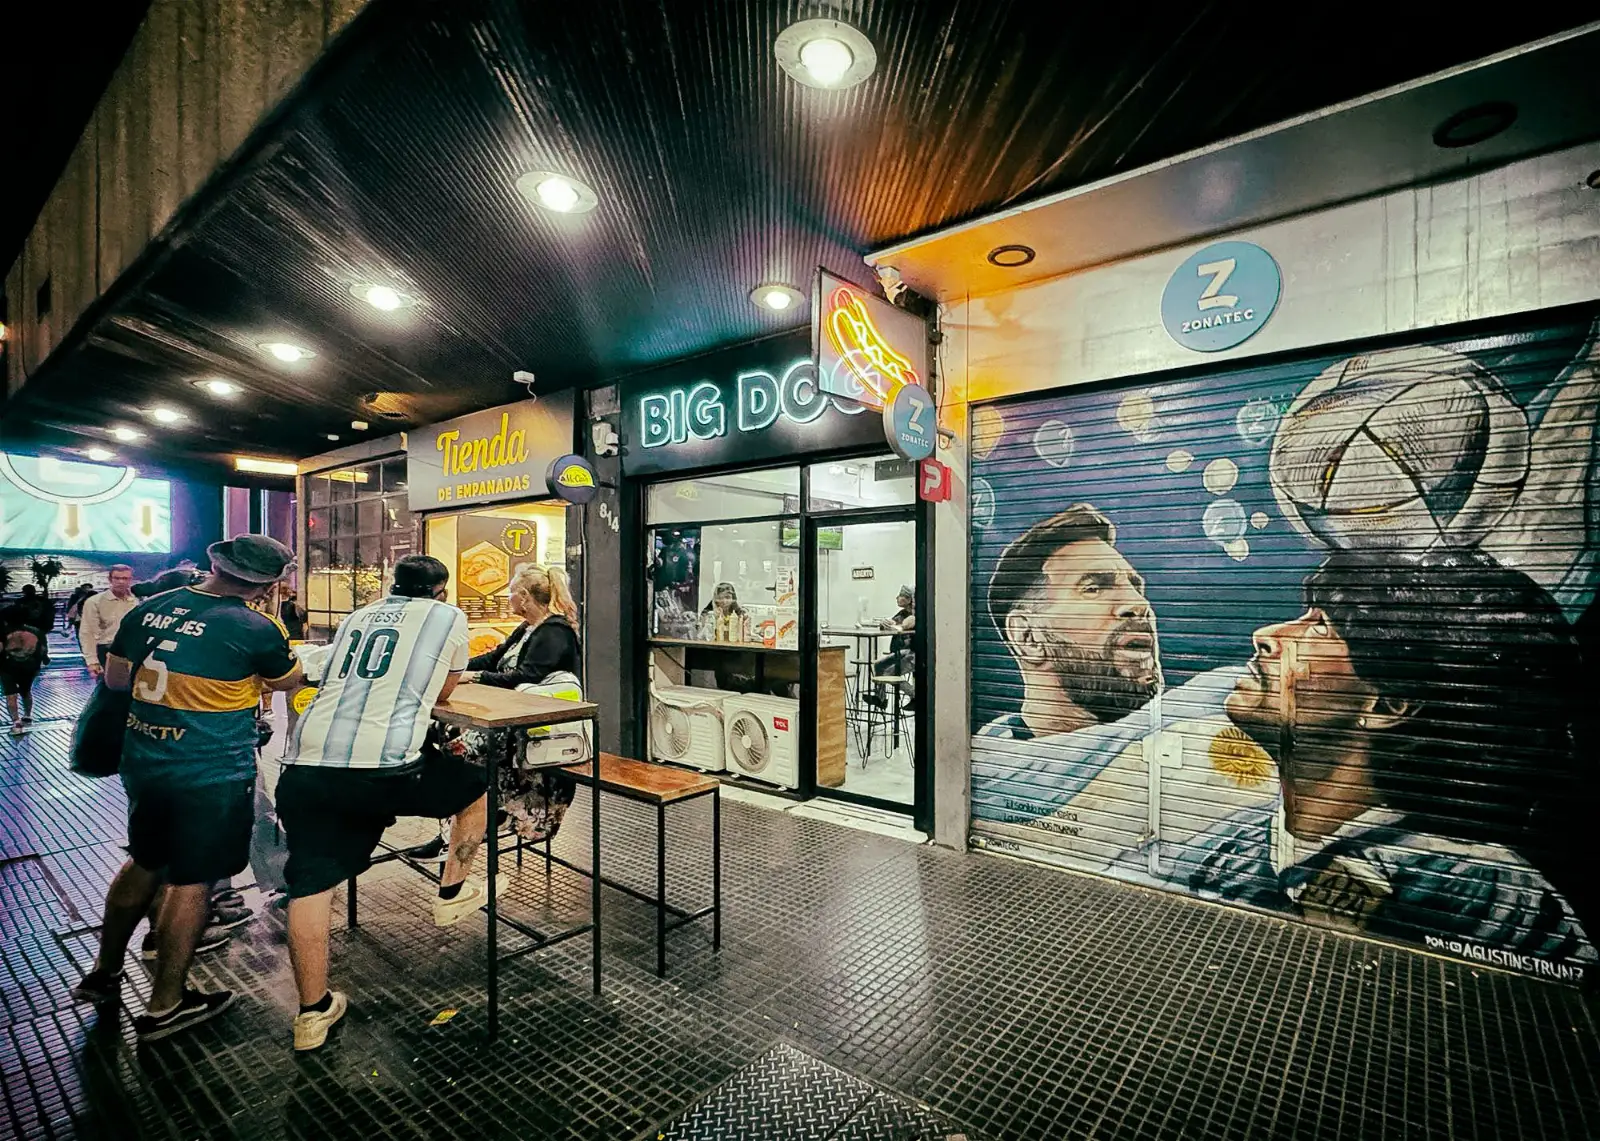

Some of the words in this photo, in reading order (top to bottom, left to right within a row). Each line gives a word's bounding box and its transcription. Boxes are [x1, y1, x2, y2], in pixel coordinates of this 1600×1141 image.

[1197, 258, 1239, 312] Z
[1181, 308, 1254, 334] ZONATEC
[641, 384, 725, 449] BIG
[908, 396, 925, 436] Z
[436, 412, 530, 477] Tienda
[901, 433, 930, 449] ZONATEC
[438, 487, 452, 502] DE
[456, 474, 531, 500] EMPANADAS
[599, 502, 620, 533] 814
[141, 612, 207, 637] PARDES
[360, 611, 408, 624] MESSI
[141, 636, 179, 702] 5
[338, 628, 400, 680] 10
